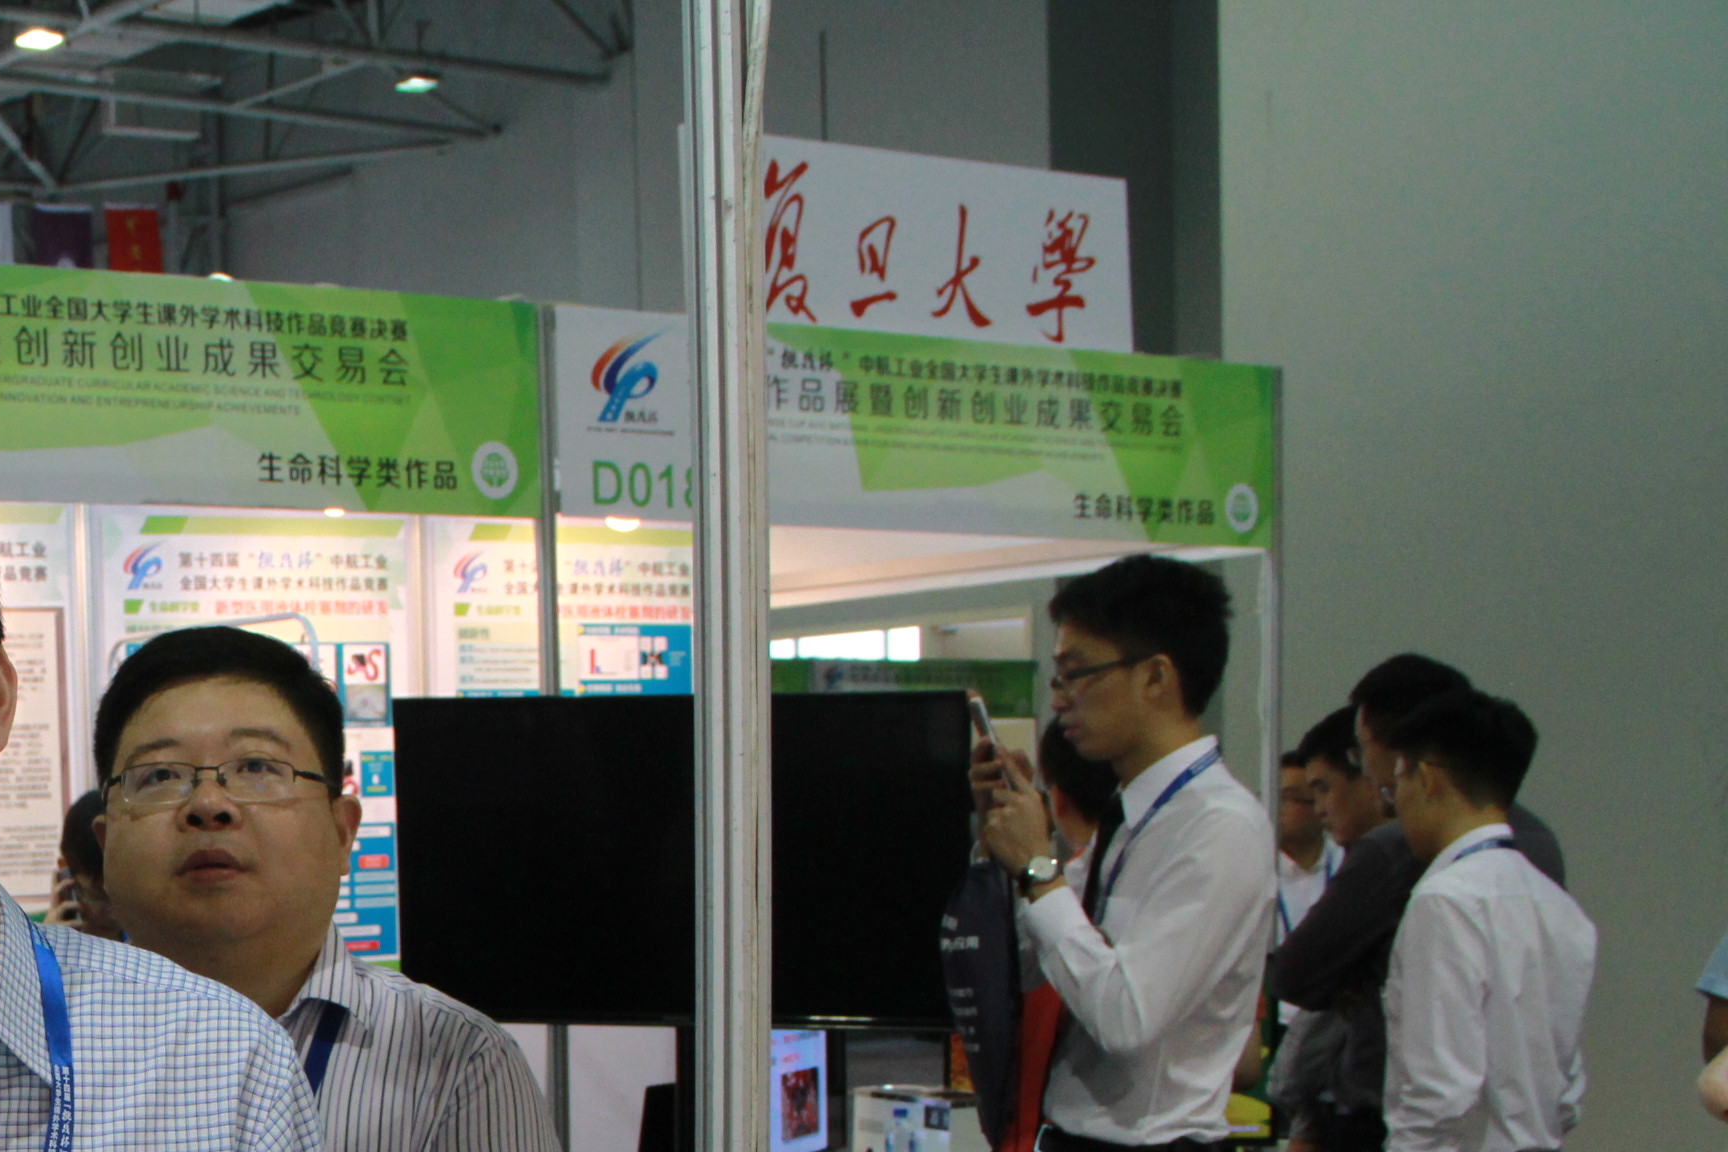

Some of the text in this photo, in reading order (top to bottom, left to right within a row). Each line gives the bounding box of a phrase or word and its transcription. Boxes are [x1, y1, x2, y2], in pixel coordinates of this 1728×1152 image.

[257, 451, 458, 491] 生命科学类作品
[1073, 491, 1216, 525] 生命科学类作品
